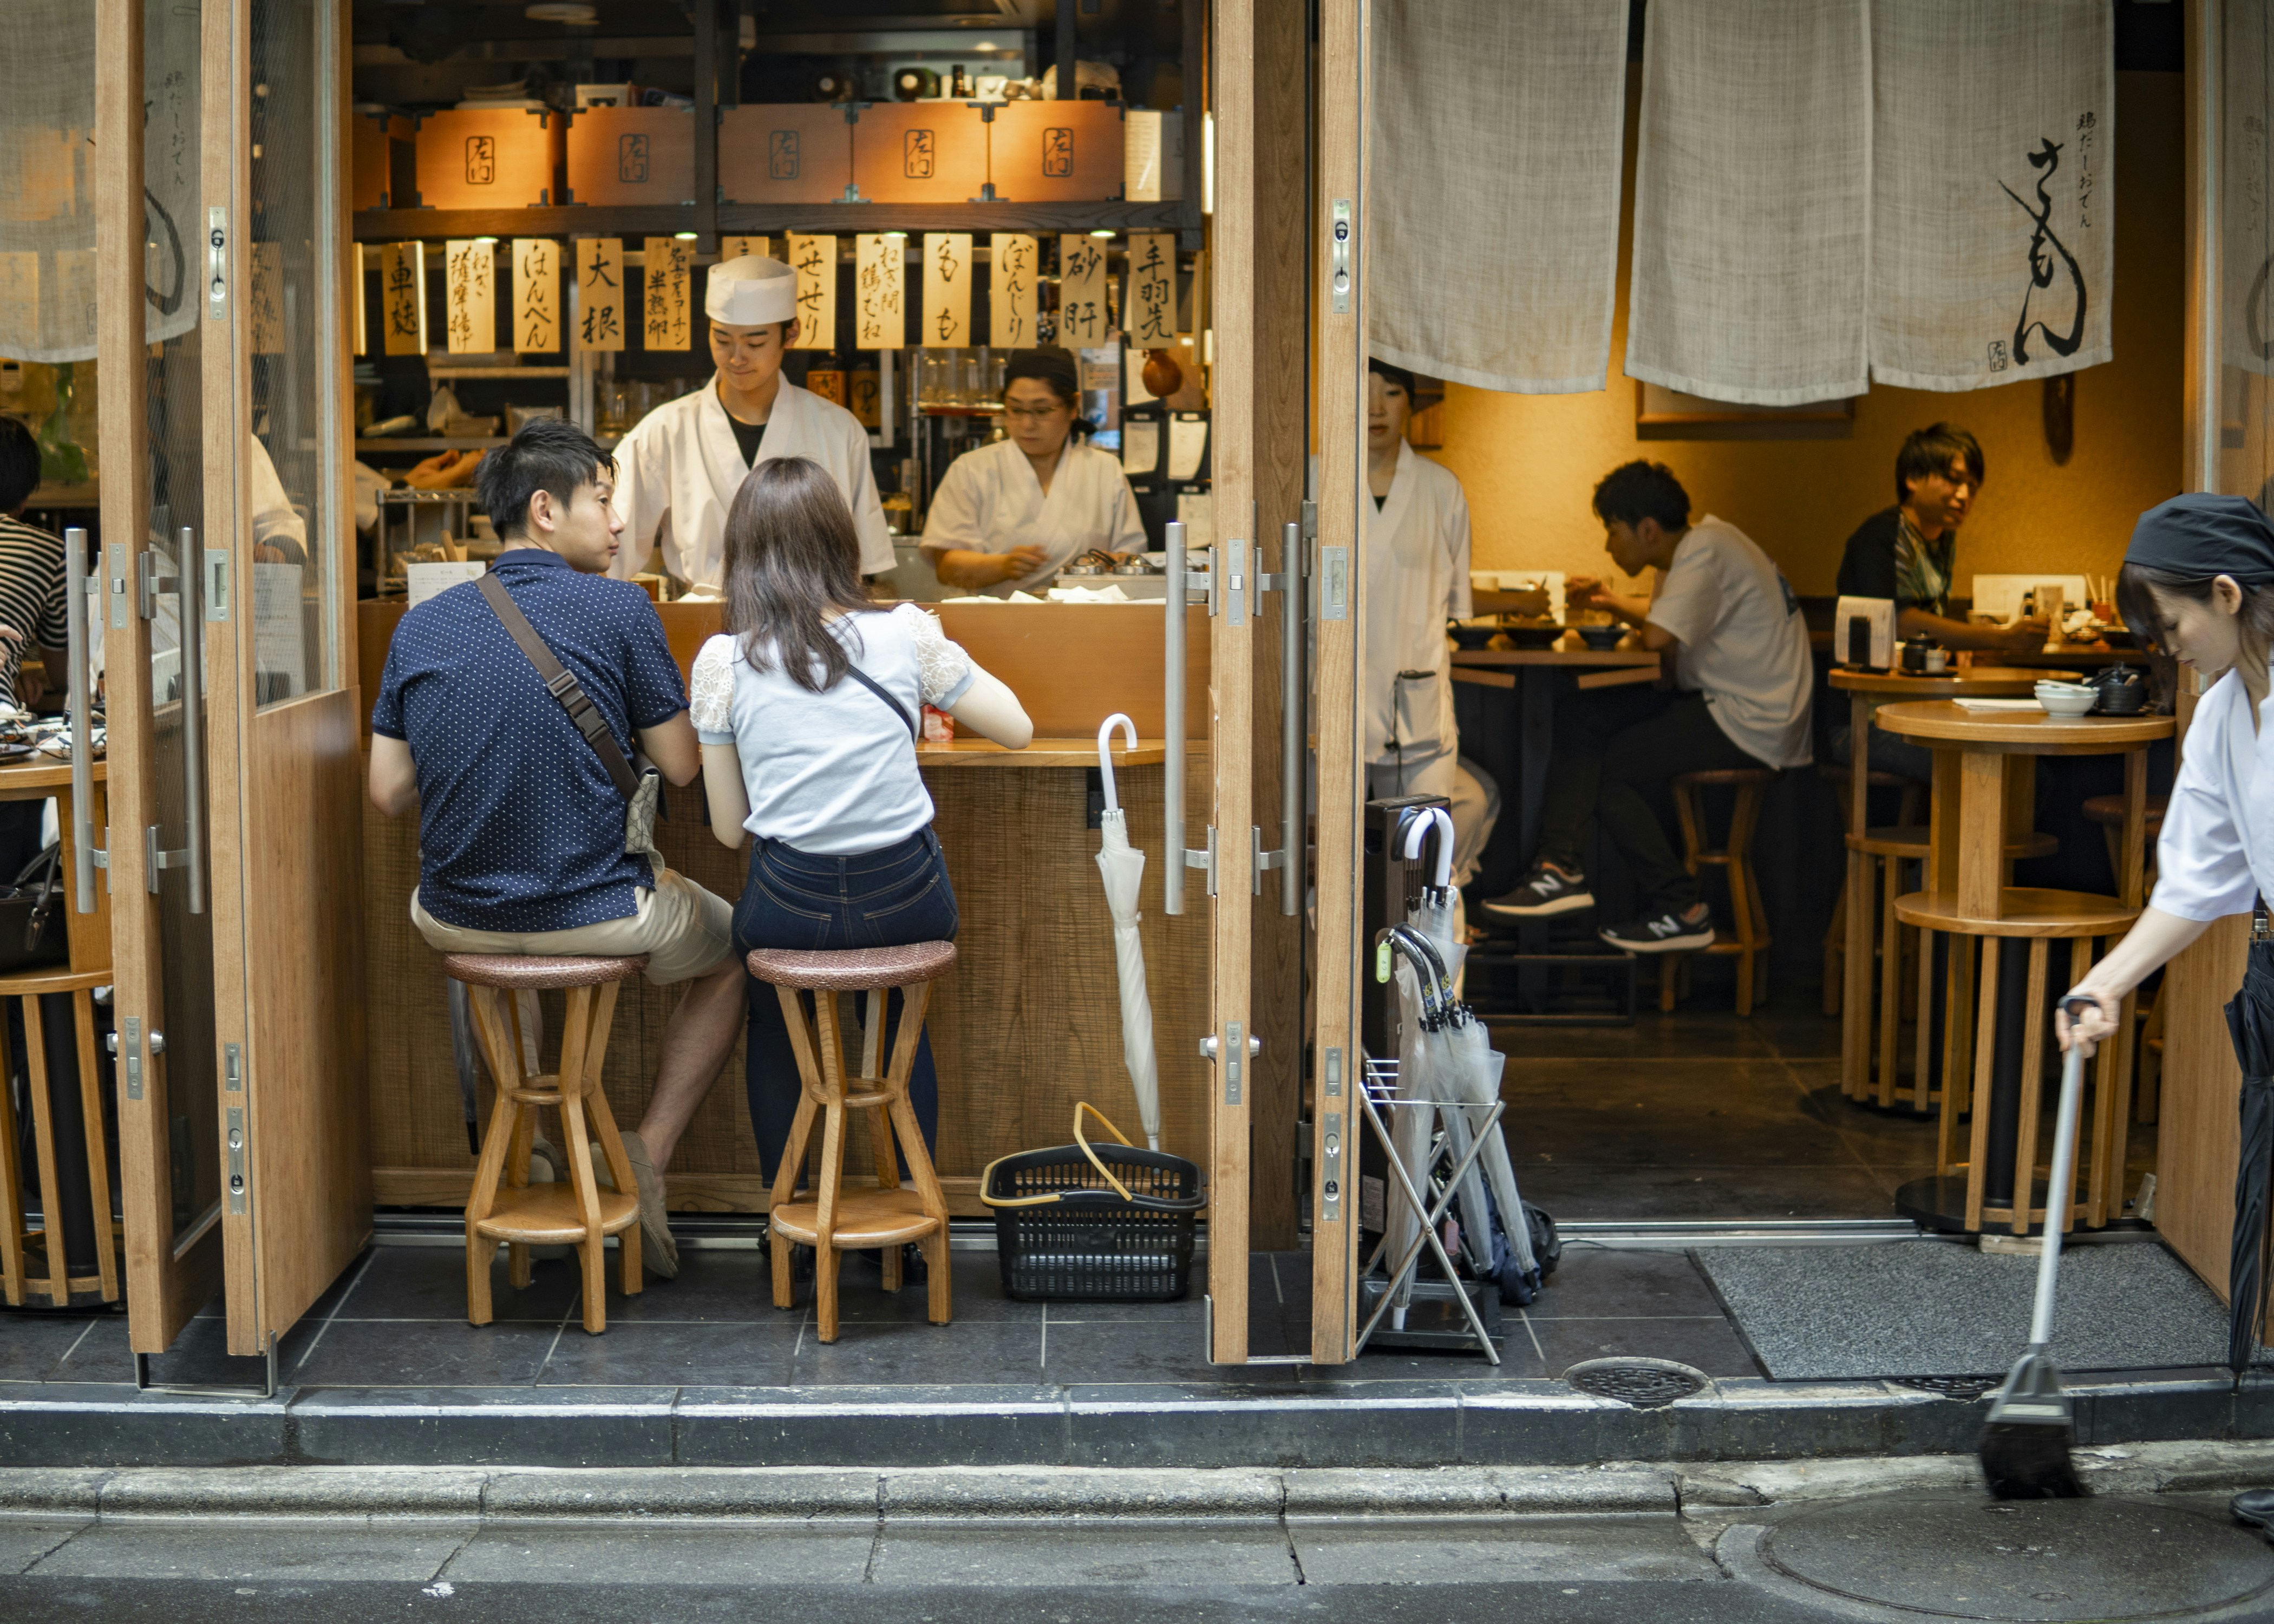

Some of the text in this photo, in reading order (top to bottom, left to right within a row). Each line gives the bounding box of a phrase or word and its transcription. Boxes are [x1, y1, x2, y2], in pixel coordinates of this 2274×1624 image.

[523, 252, 551, 348] はんぺん
[581, 252, 619, 344] 大根
[648, 270, 668, 346] 半熟卵
[668, 247, 687, 345] 名古屋コーチン
[798, 250, 824, 346] せせり
[880, 247, 900, 315] ねぎ間
[936, 248, 958, 341] もも
[1002, 244, 1033, 345] ぼんじり
[1065, 245, 1102, 339] 砂肝
[1136, 245, 1173, 341] 手羽先
[1530, 874, 1562, 897] N
[1648, 915, 1681, 939] N
